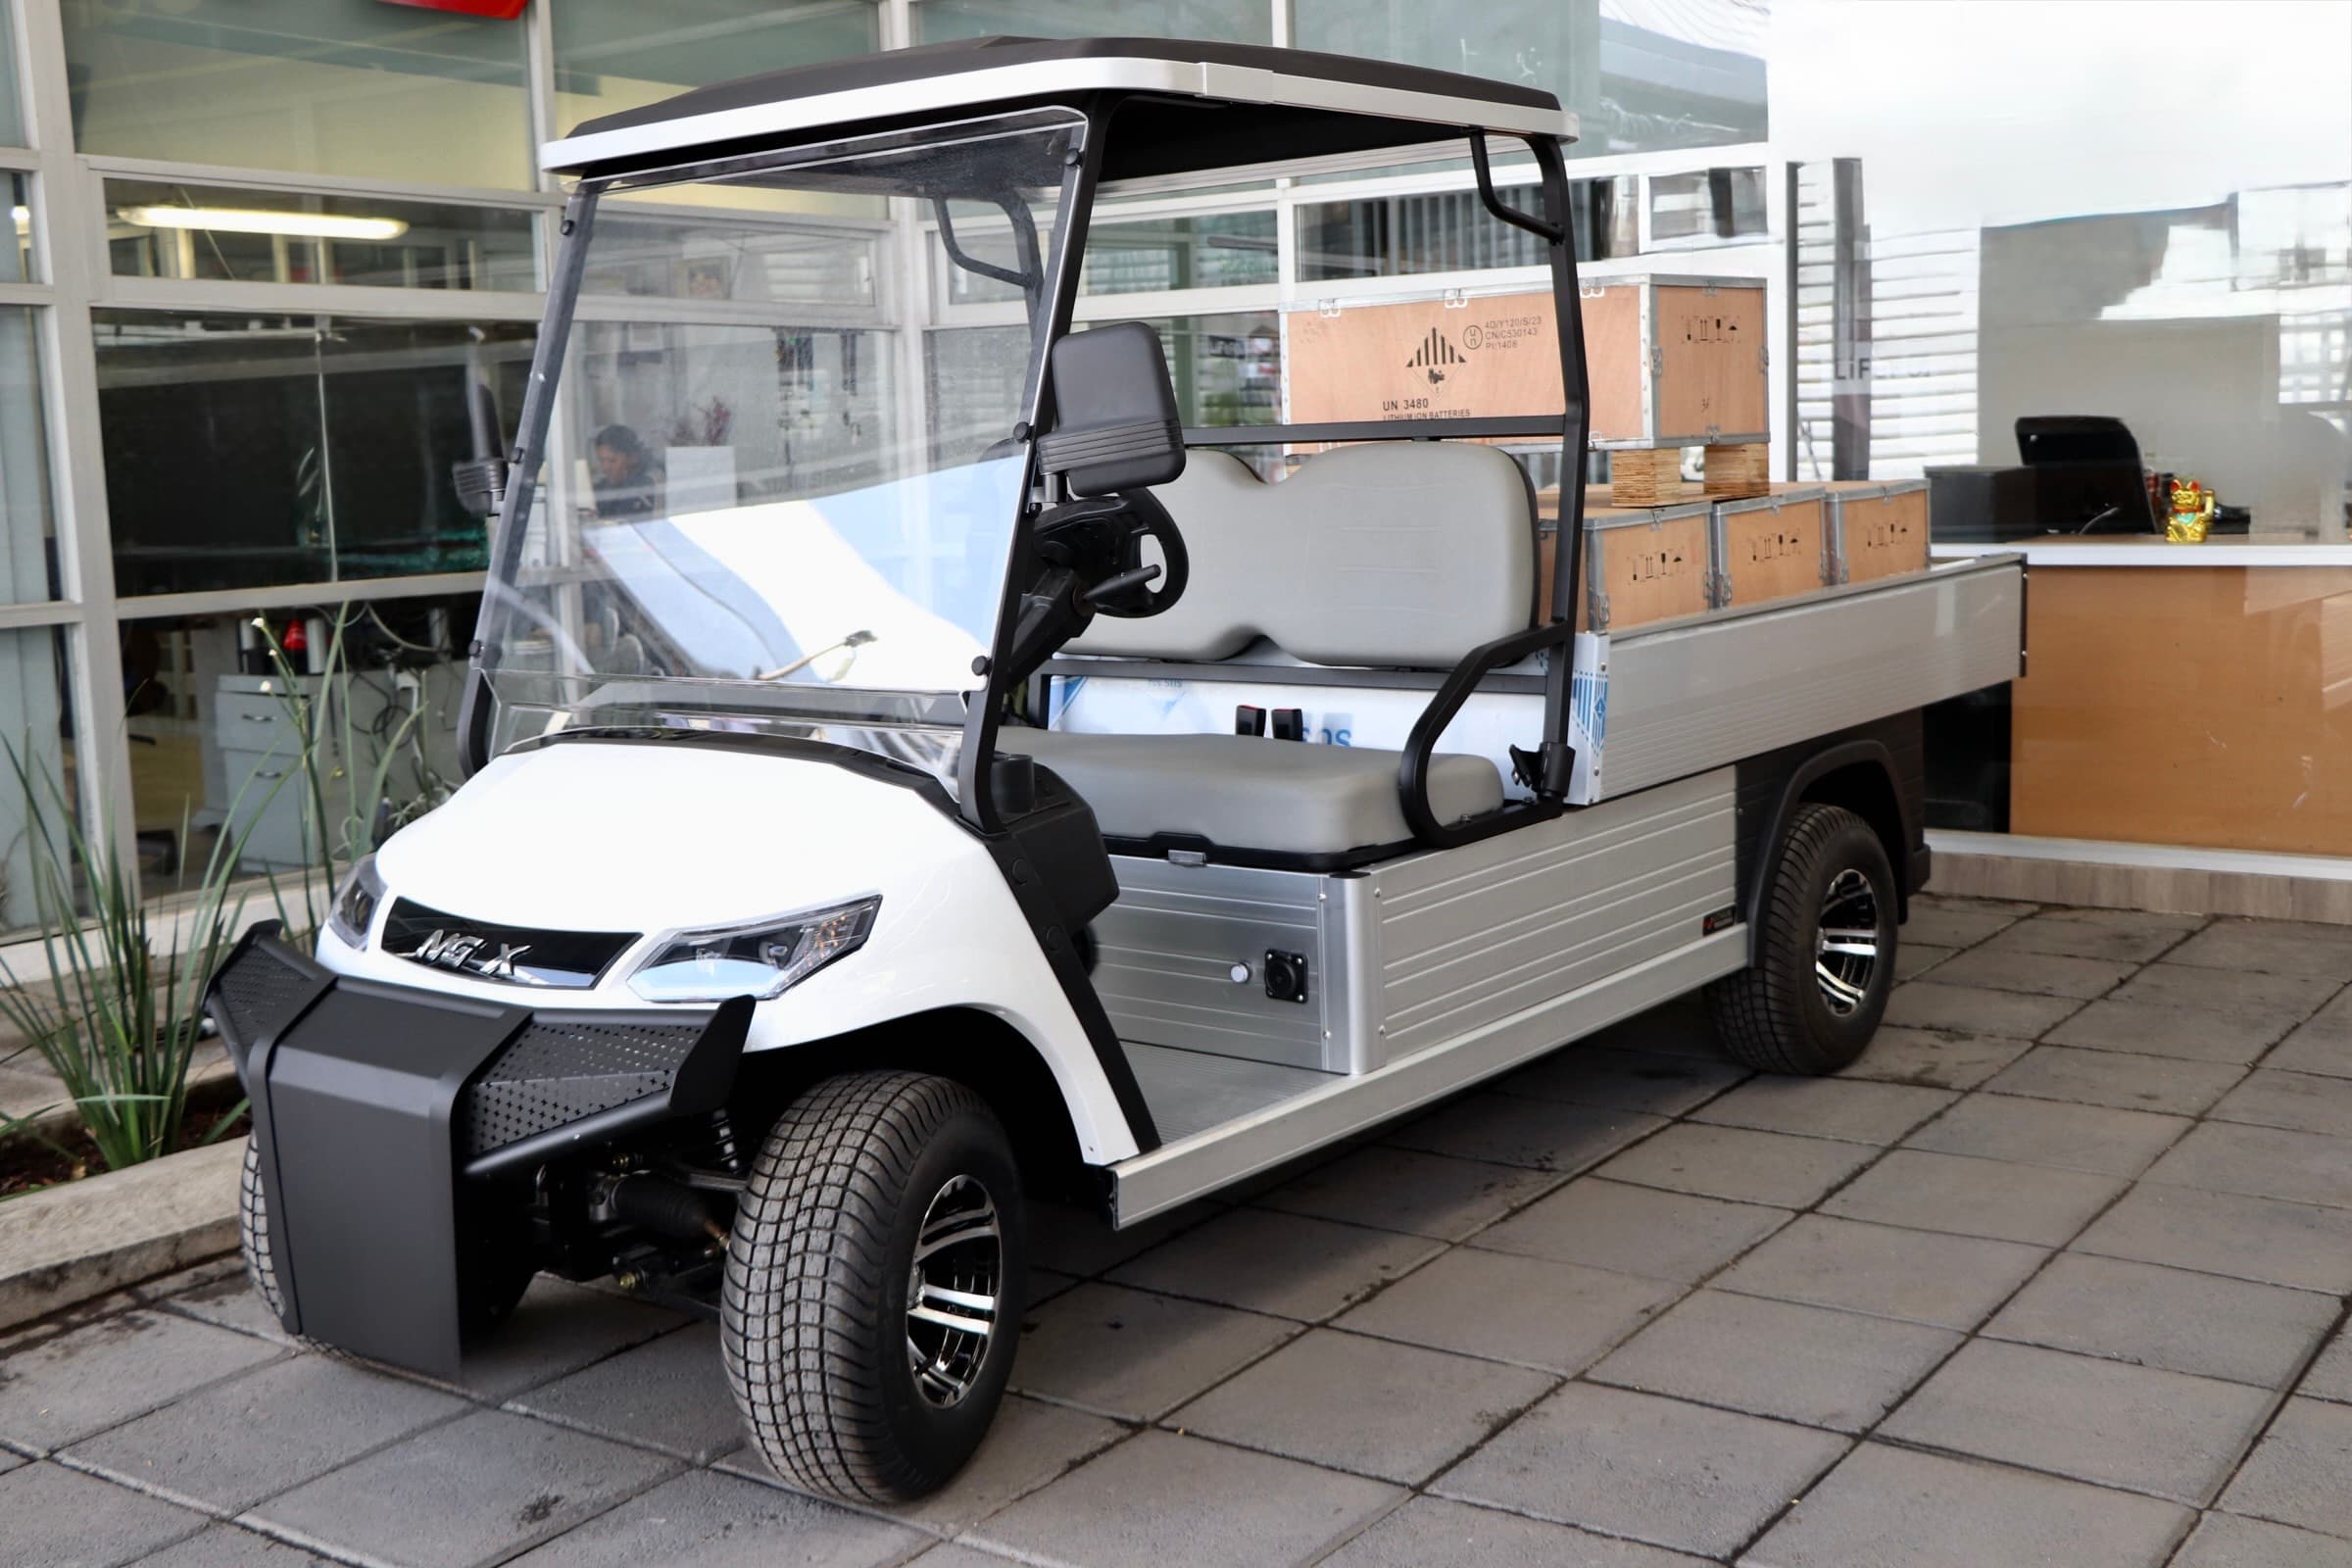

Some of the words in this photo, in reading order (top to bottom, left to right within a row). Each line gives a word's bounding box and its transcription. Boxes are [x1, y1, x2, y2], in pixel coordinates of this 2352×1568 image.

[1382, 400, 1398, 412] UN
[1402, 398, 1429, 410] 3480
[1428, 409, 1471, 419] BATTERIES
